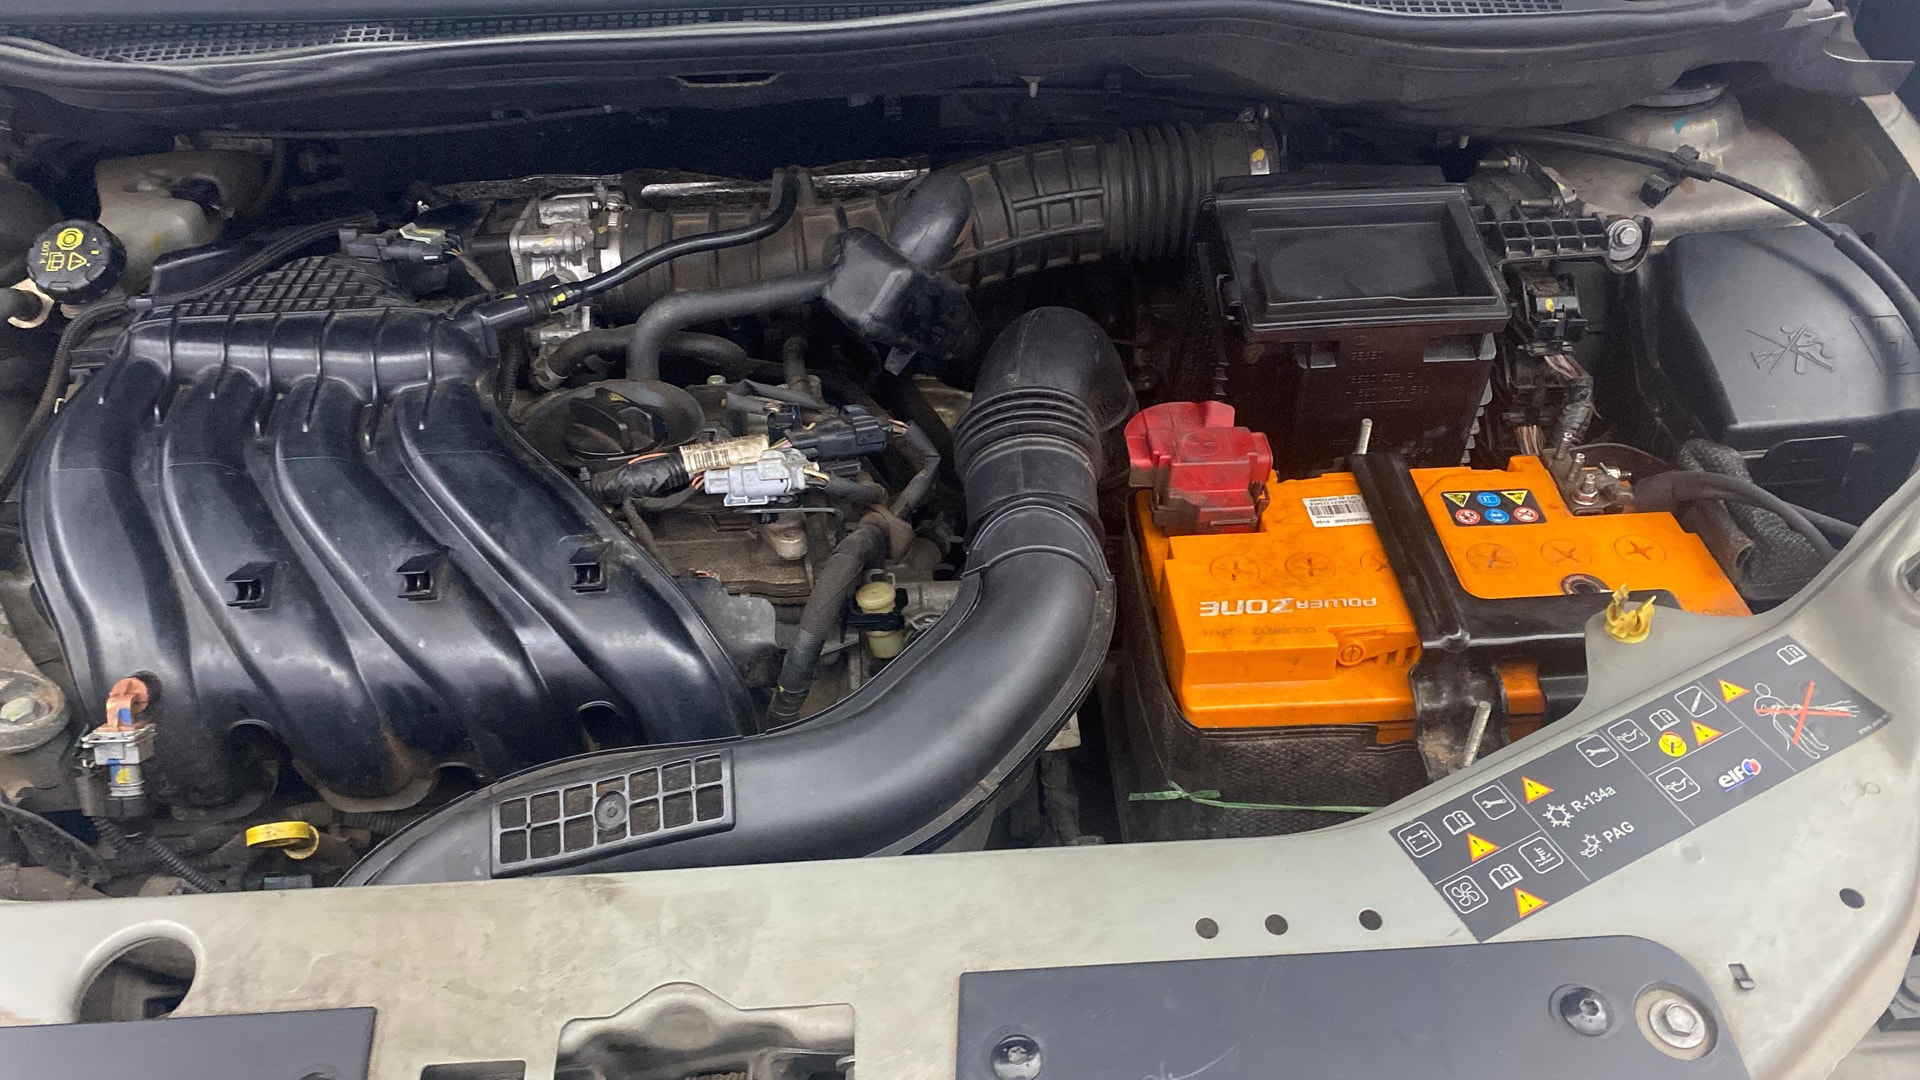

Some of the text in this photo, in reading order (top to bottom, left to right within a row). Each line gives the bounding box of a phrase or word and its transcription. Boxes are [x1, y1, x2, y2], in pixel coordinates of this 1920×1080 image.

[41, 241, 51, 256] DOT
[1718, 765, 1745, 788] elf
[1570, 786, 1617, 812] R-134a
[1602, 821, 1635, 843] PAG
